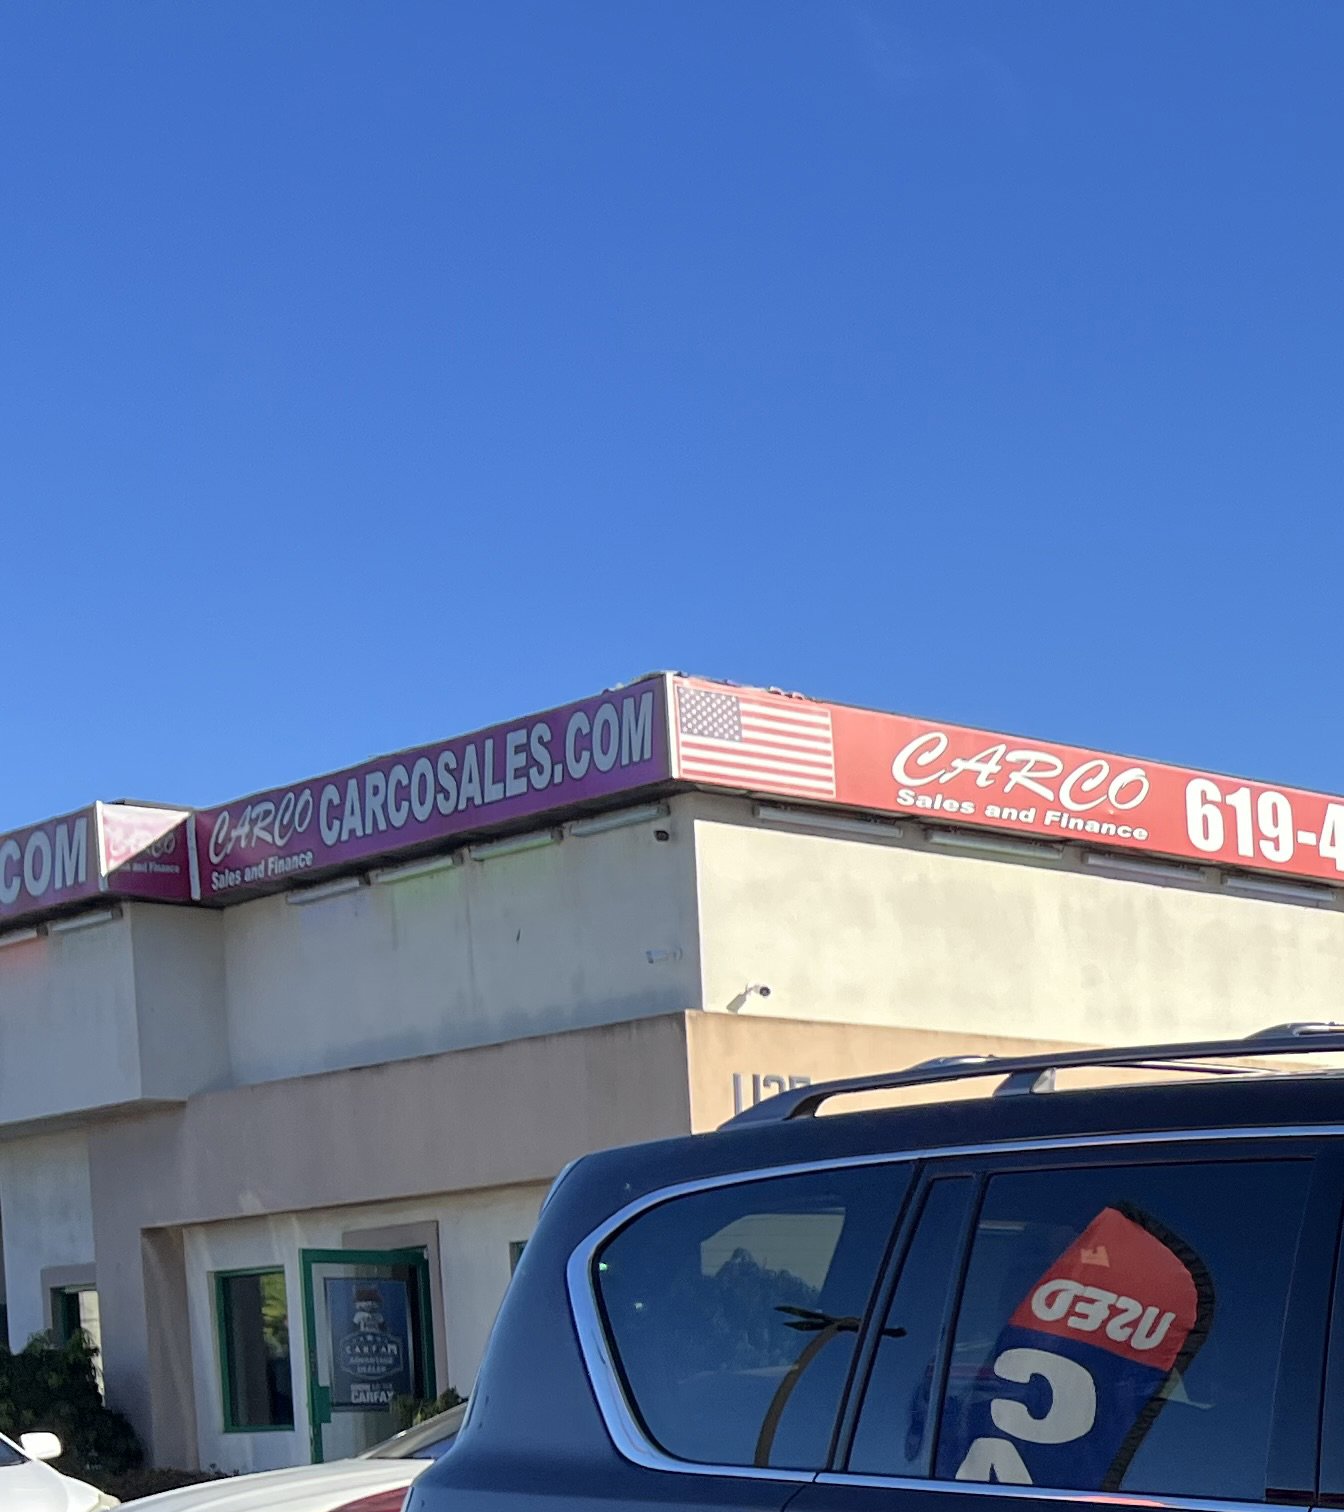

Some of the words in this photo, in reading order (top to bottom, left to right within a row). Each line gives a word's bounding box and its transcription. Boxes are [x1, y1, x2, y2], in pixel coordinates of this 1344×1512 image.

[320, 691, 654, 847] CARCOSALES.COM
[891, 732, 1149, 811] CARCO
[209, 788, 313, 865] CARCO
[896, 789, 976, 814] Sales
[985, 803, 1036, 824] and
[1043, 810, 1149, 840] Finance
[211, 868, 242, 891] Sales
[244, 858, 265, 882] and
[268, 849, 313, 877] Finance
